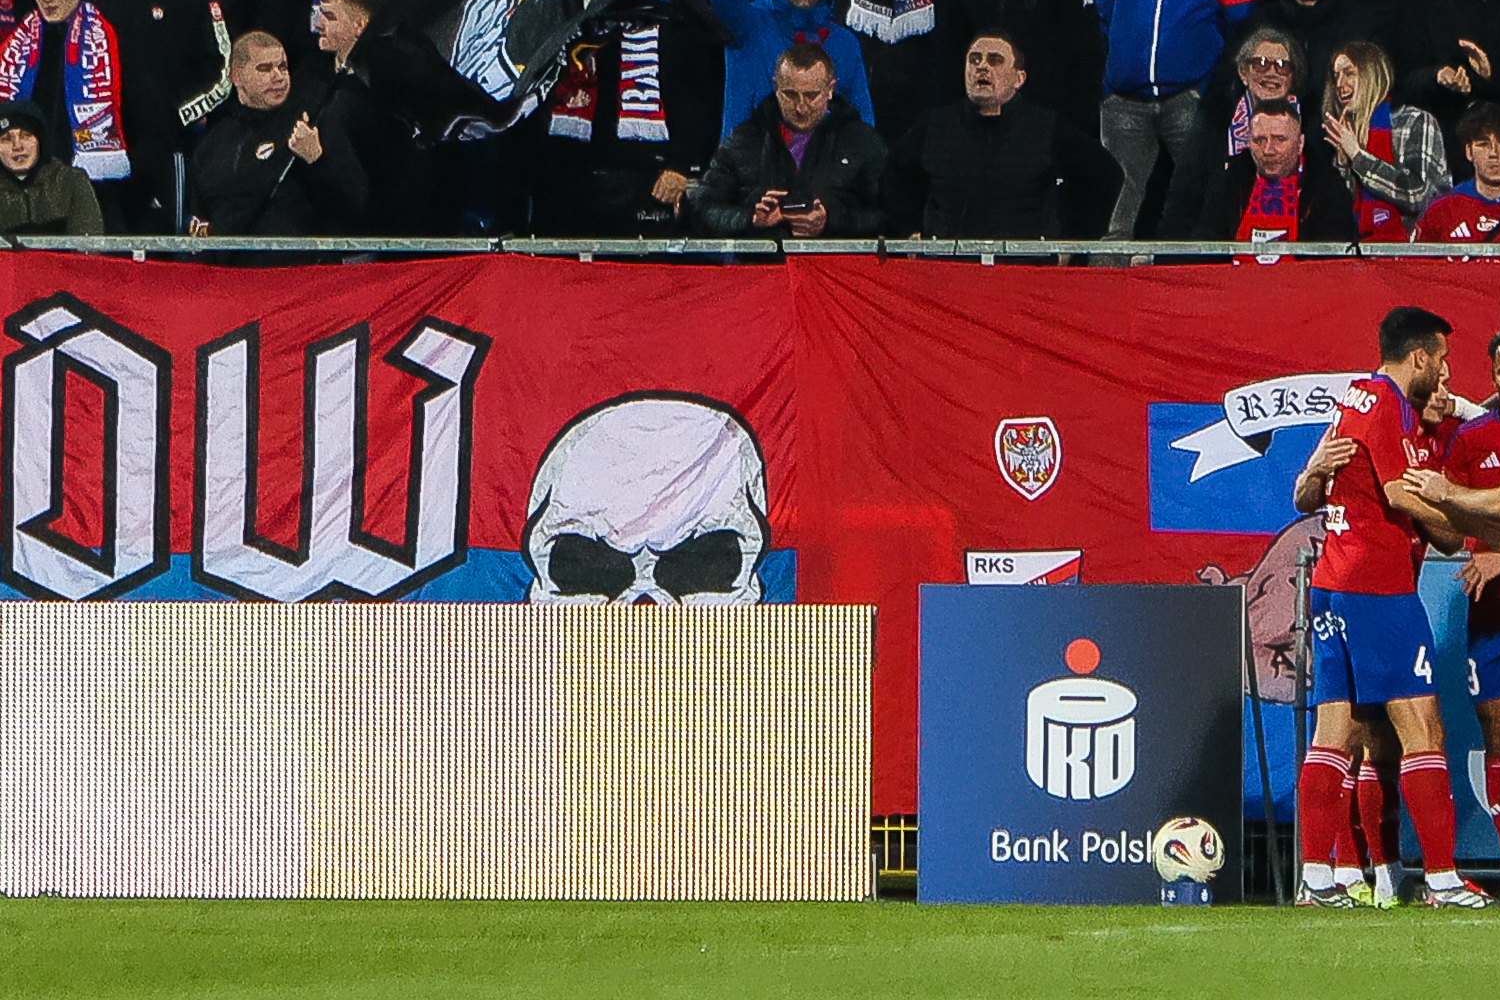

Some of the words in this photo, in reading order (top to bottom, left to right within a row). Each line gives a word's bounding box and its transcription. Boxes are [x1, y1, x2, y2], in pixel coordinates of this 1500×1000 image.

[974, 557, 1015, 574] RKS
[1413, 644, 1433, 685] 4
[991, 829, 1070, 864] Bank
[1082, 829, 1154, 864] Pols
